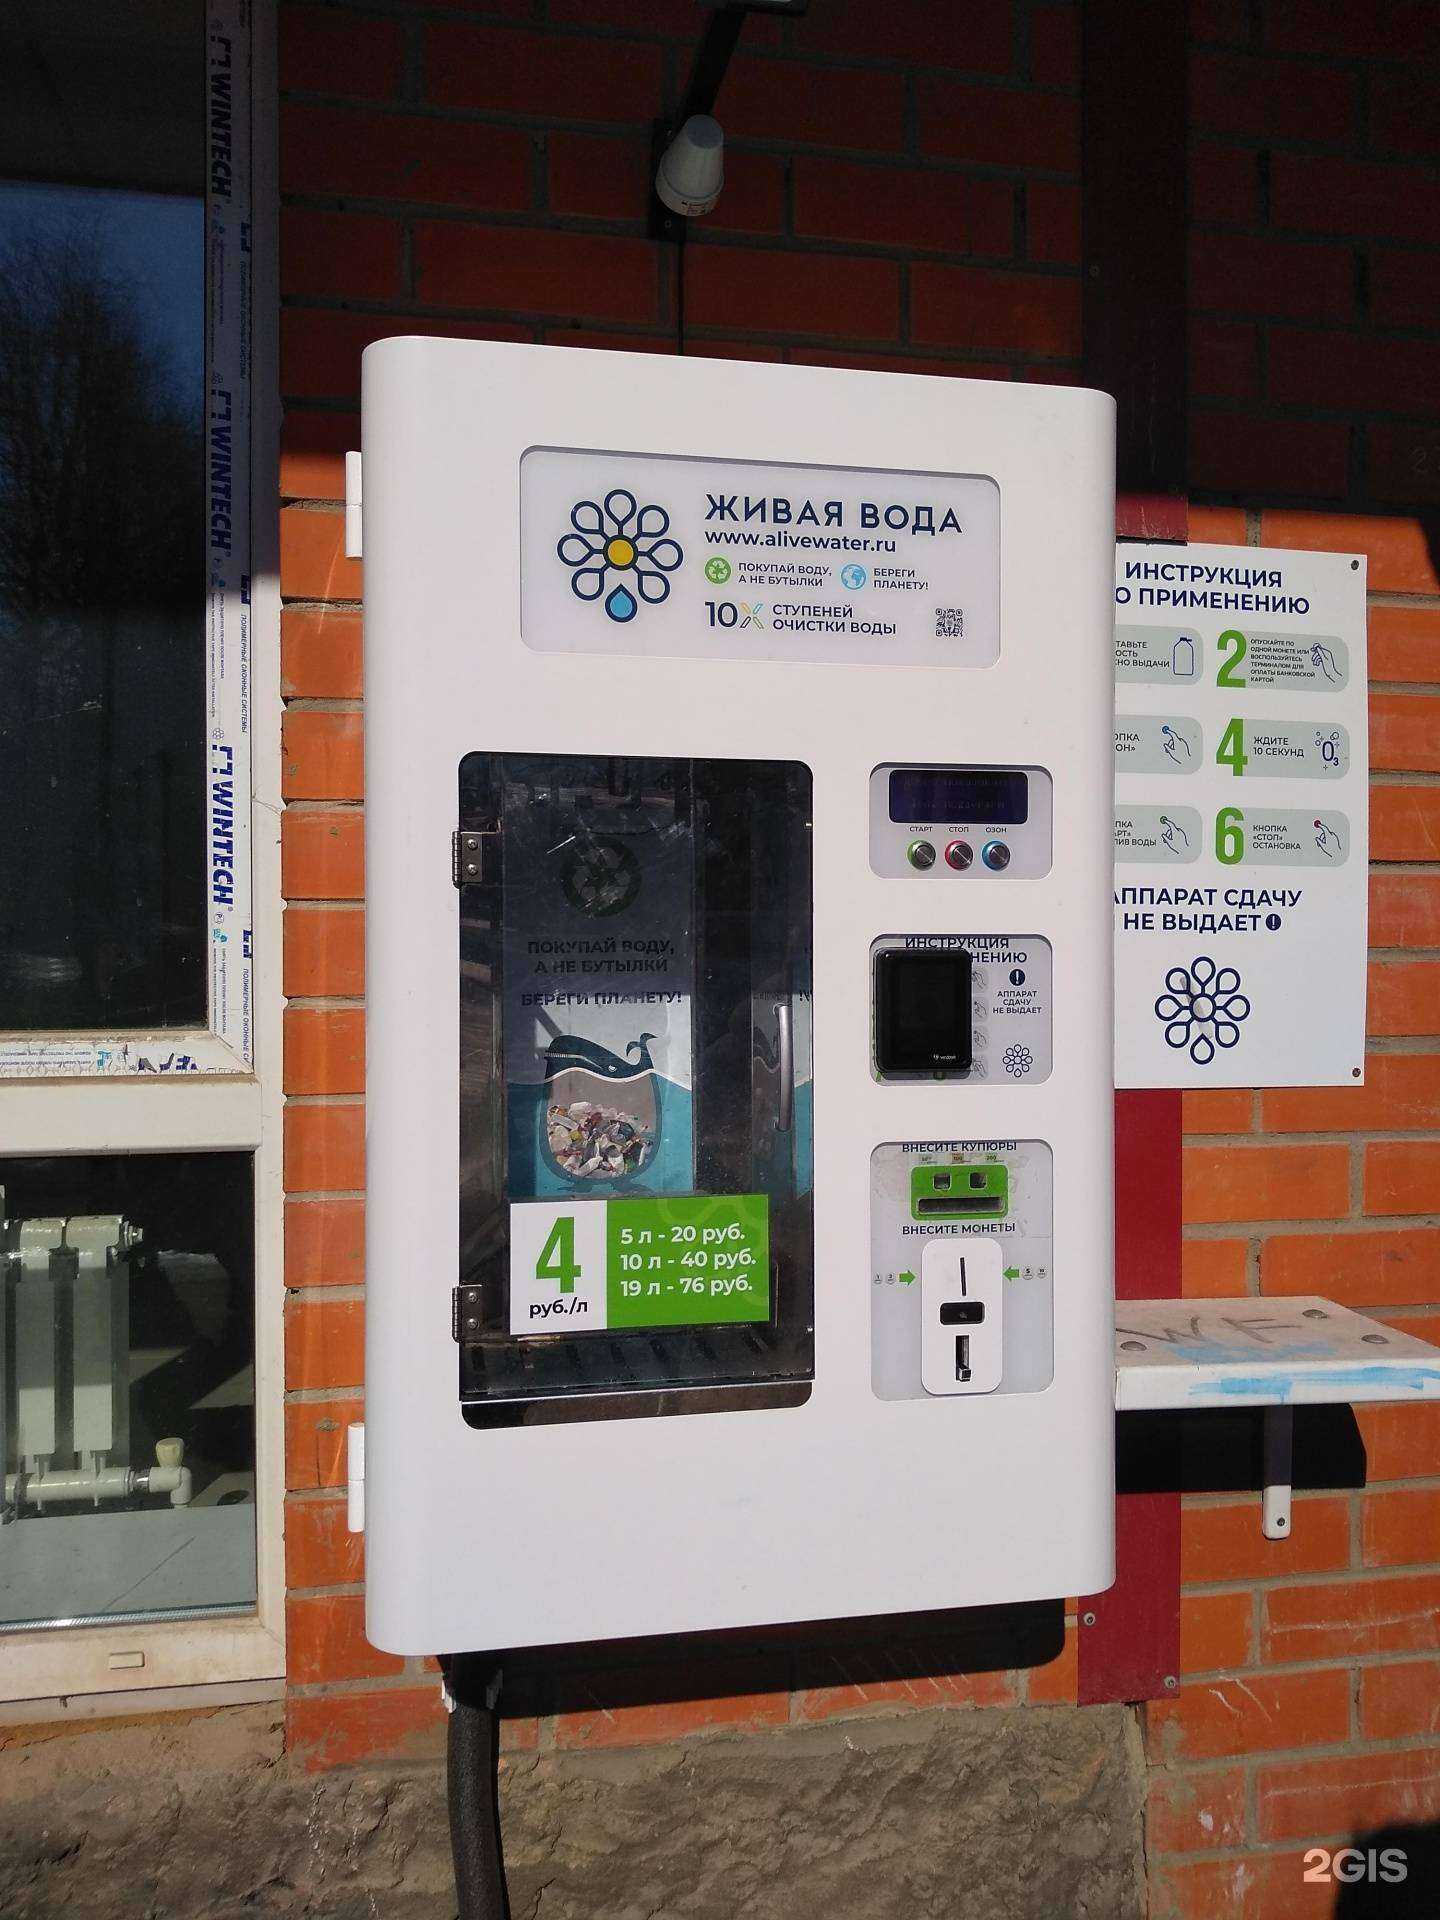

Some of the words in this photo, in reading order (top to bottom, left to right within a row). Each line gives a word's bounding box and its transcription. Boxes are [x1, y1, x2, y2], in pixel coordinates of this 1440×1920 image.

[211, 72, 232, 198] WINTECH
[211, 425, 232, 552] WINTECH
[705, 493, 844, 528] ЖИВАЯ
[861, 502, 963, 536] ВОДА
[704, 529, 896, 553] www.alivewater.ru
[738, 561, 795, 575] ПОКУПАЙ
[798, 564, 832, 577] ВОДУ,
[873, 567, 916, 579] БЕРЕГИ
[1125, 561, 1283, 589] ИНСТРУКЦИЯ
[738, 575, 747, 586] А
[749, 576, 765, 587] НЕ
[768, 577, 824, 588] БУТЫЛКИ
[873, 579, 929, 591] ПЛАНЕТУ!
[1115, 588, 1131, 605] О
[1138, 588, 1310, 615] ПРИМЕНЕНИЮ
[772, 602, 854, 619] СТУПЕНЕЙ
[772, 618, 846, 634] ОЧИСТКИ
[850, 621, 897, 636] ВОДЫ
[1115, 640, 1148, 649] ТАВЬТЕ
[1115, 650, 1138, 658] ОСТЬ
[1216, 629, 1247, 689] 2
[1132, 660, 1170, 669] ВЫДАЧИ
[1215, 718, 1248, 777] 4
[1253, 736, 1289, 746] ЖДИТЕ
[1253, 747, 1263, 756] 10
[1265, 748, 1305, 758] СЕКУНД
[985, 826, 1007, 834] ОЗОН
[1214, 806, 1245, 865] 6
[1253, 824, 1288, 833] КНОПКА
[213, 780, 234, 906] WINTECH
[1131, 838, 1157, 847] ВОДЫ
[1252, 841, 1302, 850] ОСТАНОВКА
[1224, 888, 1303, 910] СДАЧУ
[1123, 912, 1155, 931] НЕ
[1162, 913, 1262, 934] ВЫДАЕТ
[527, 936, 617, 954] ПОКУПАЙ
[905, 936, 1010, 951] ИНСТРУКЦИЯ
[969, 951, 1027, 964] НЕНИЮ
[534, 961, 548, 974] А
[553, 960, 577, 973] НЕ
[581, 959, 668, 973] БУТЫЛКИ
[520, 992, 590, 1006] БЕРЕГИ
[593, 991, 683, 1006] ПЛАНЕТУ!
[997, 990, 1037, 999] АППАРАТ
[1003, 998, 1031, 1007] СДАЧУ
[992, 1006, 1005, 1014] НЕ
[1006, 1006, 1042, 1016] ВЫДАЕТ
[902, 1142, 958, 1153] ВНЕСИТЕ
[961, 1141, 1017, 1153] КУПЮРЫ
[620, 1228, 633, 1245] 5
[638, 1231, 652, 1243] л
[671, 1225, 697, 1243] 20
[702, 1222, 745, 1245] руб.
[902, 1224, 958, 1236] ВНЕСИТЕ
[961, 1222, 1016, 1234] МОНЕТЫ
[535, 1216, 582, 1294] 4
[620, 1254, 643, 1271] 10
[647, 1257, 661, 1269] л
[680, 1250, 708, 1268] 40
[713, 1247, 757, 1270] руб.
[620, 1280, 642, 1297] 19
[646, 1283, 661, 1295] л
[679, 1276, 705, 1294] 76
[710, 1274, 753, 1297] руб.
[528, 1296, 588, 1319] руб./л
